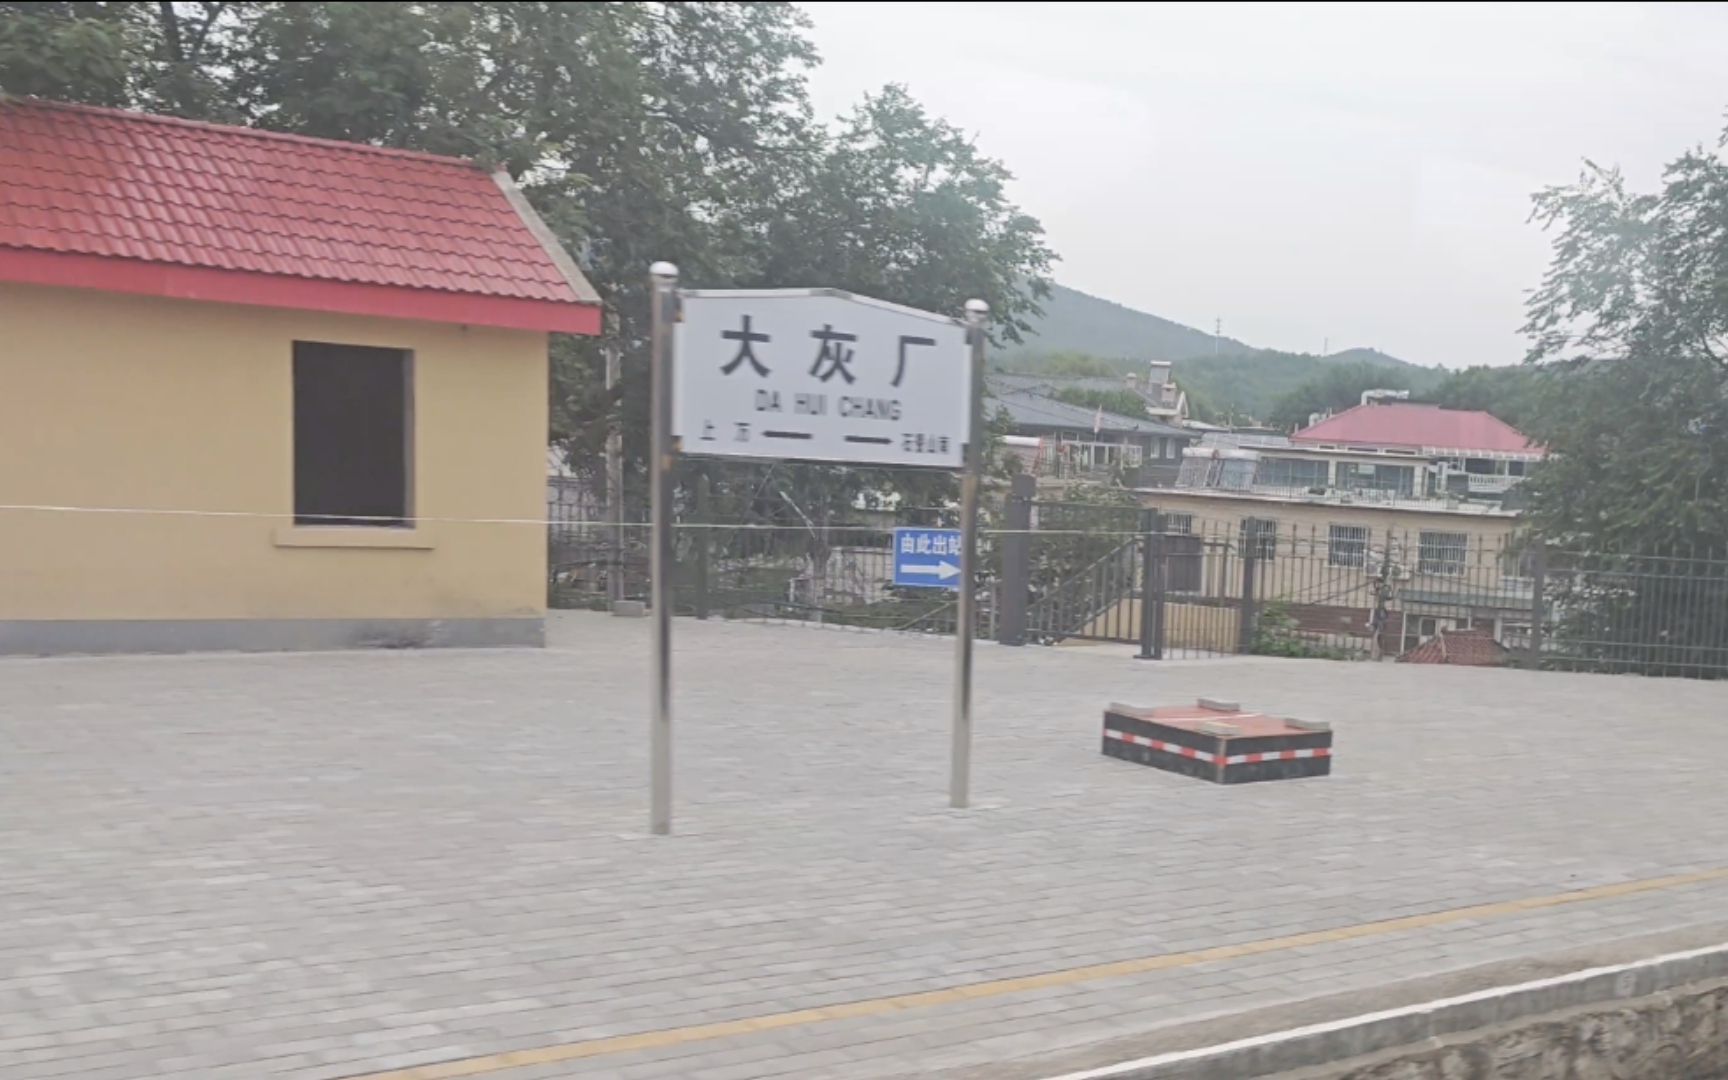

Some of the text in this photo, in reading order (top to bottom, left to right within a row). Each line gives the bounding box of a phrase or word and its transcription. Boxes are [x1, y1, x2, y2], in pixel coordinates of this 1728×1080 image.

[720, 314, 937, 388] 大灰厂
[755, 389, 903, 421] DA HUI CHANG
